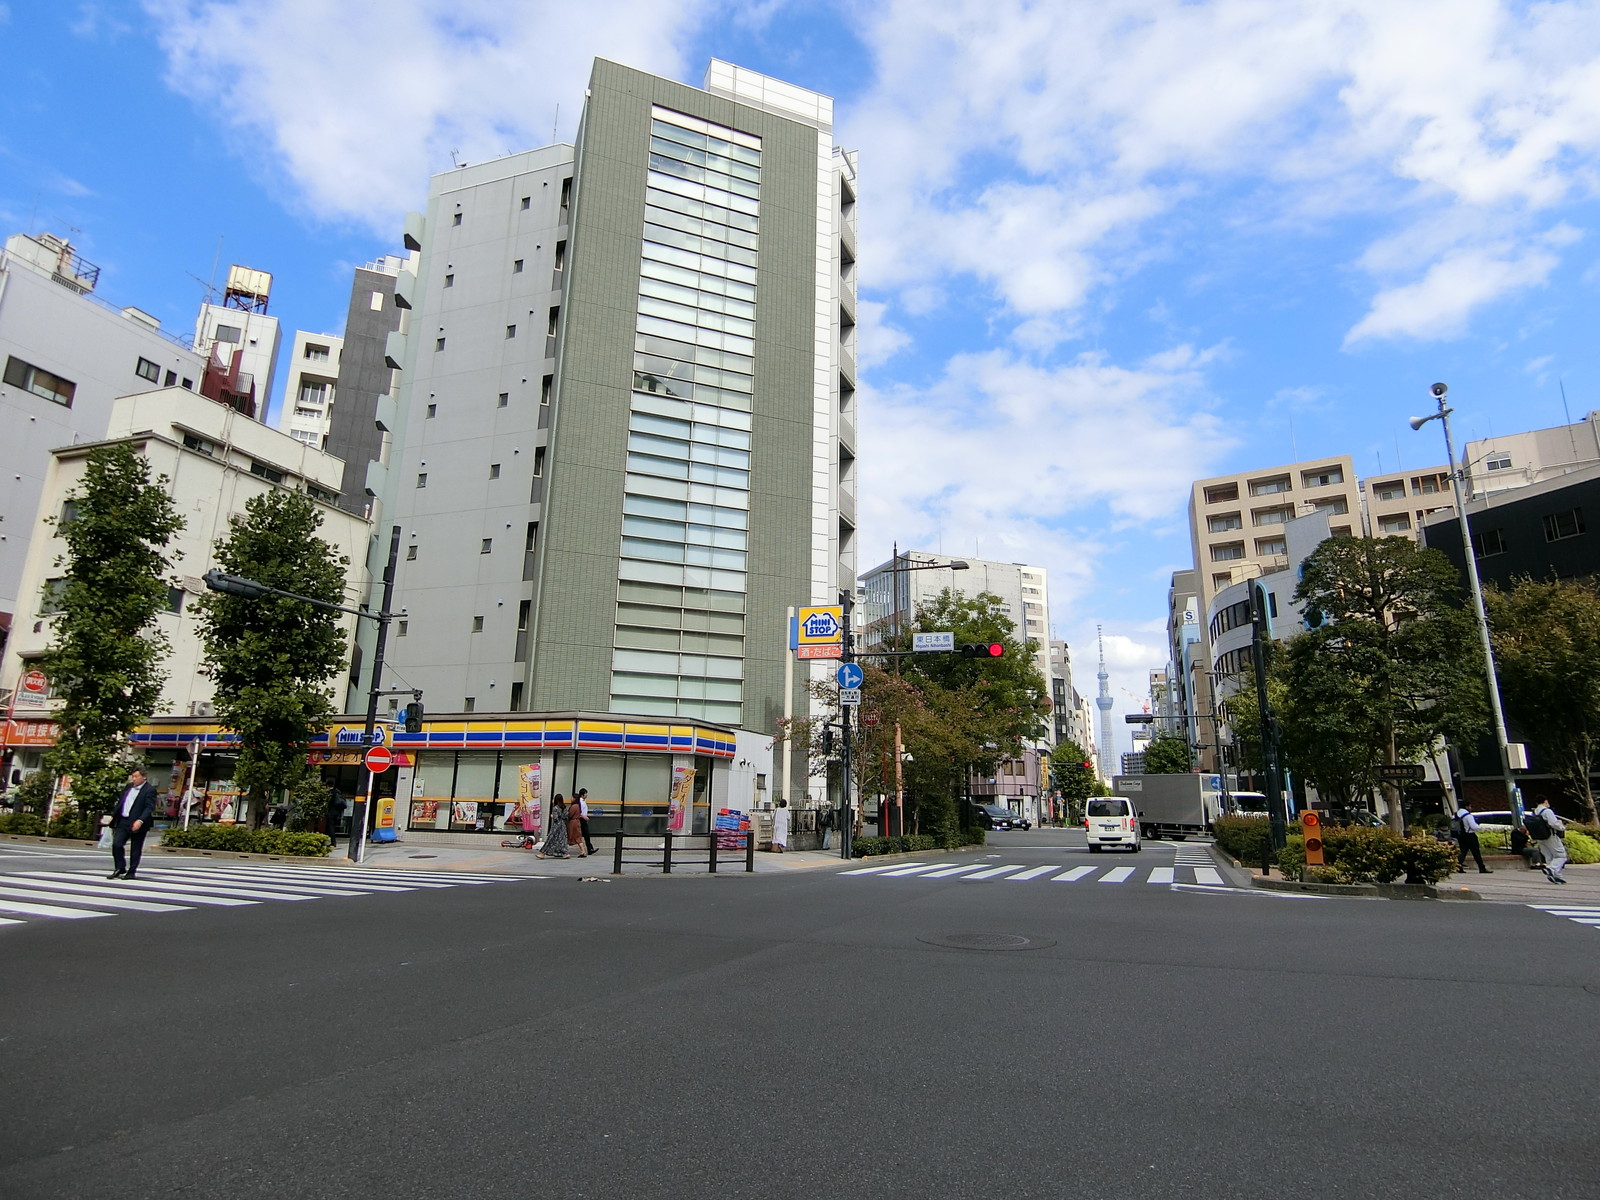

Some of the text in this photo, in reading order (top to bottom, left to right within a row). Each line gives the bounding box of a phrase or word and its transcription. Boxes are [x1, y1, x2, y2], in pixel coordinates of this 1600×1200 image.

[1186, 612, 1193, 620] S
[809, 626, 832, 634] STOP
[916, 635, 950, 643] 東日本橋
[801, 647, 840, 657] 酒・たばこ
[340, 733, 359, 742] MINI
